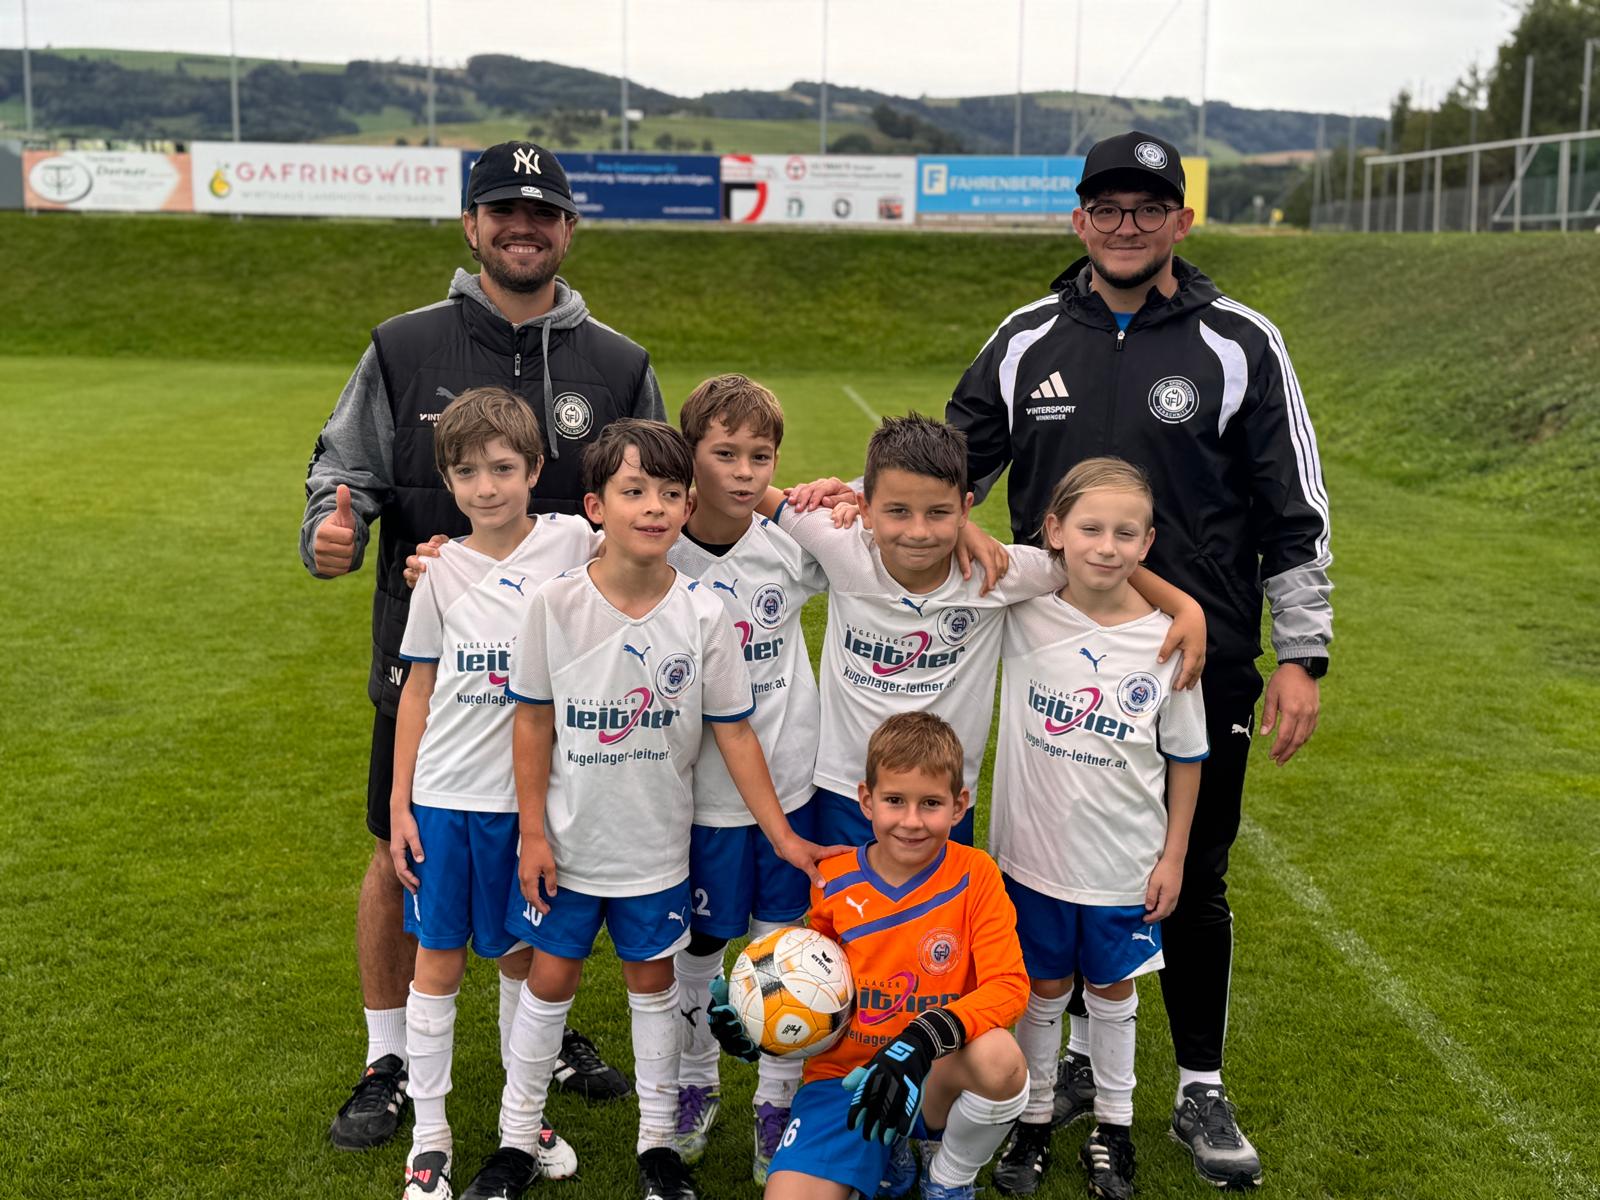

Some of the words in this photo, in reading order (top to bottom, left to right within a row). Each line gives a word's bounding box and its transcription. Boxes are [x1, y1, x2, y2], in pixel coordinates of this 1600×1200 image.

[235, 160, 448, 186] GAFRINGWIRT
[457, 650, 511, 672] leit
[844, 629, 966, 669] leitner
[567, 697, 636, 706] KUGELLAGER
[1029, 679, 1085, 705] KUGELLAGER
[566, 704, 680, 730] leitner
[1028, 685, 1135, 741] leitner
[859, 987, 960, 1012] itner
